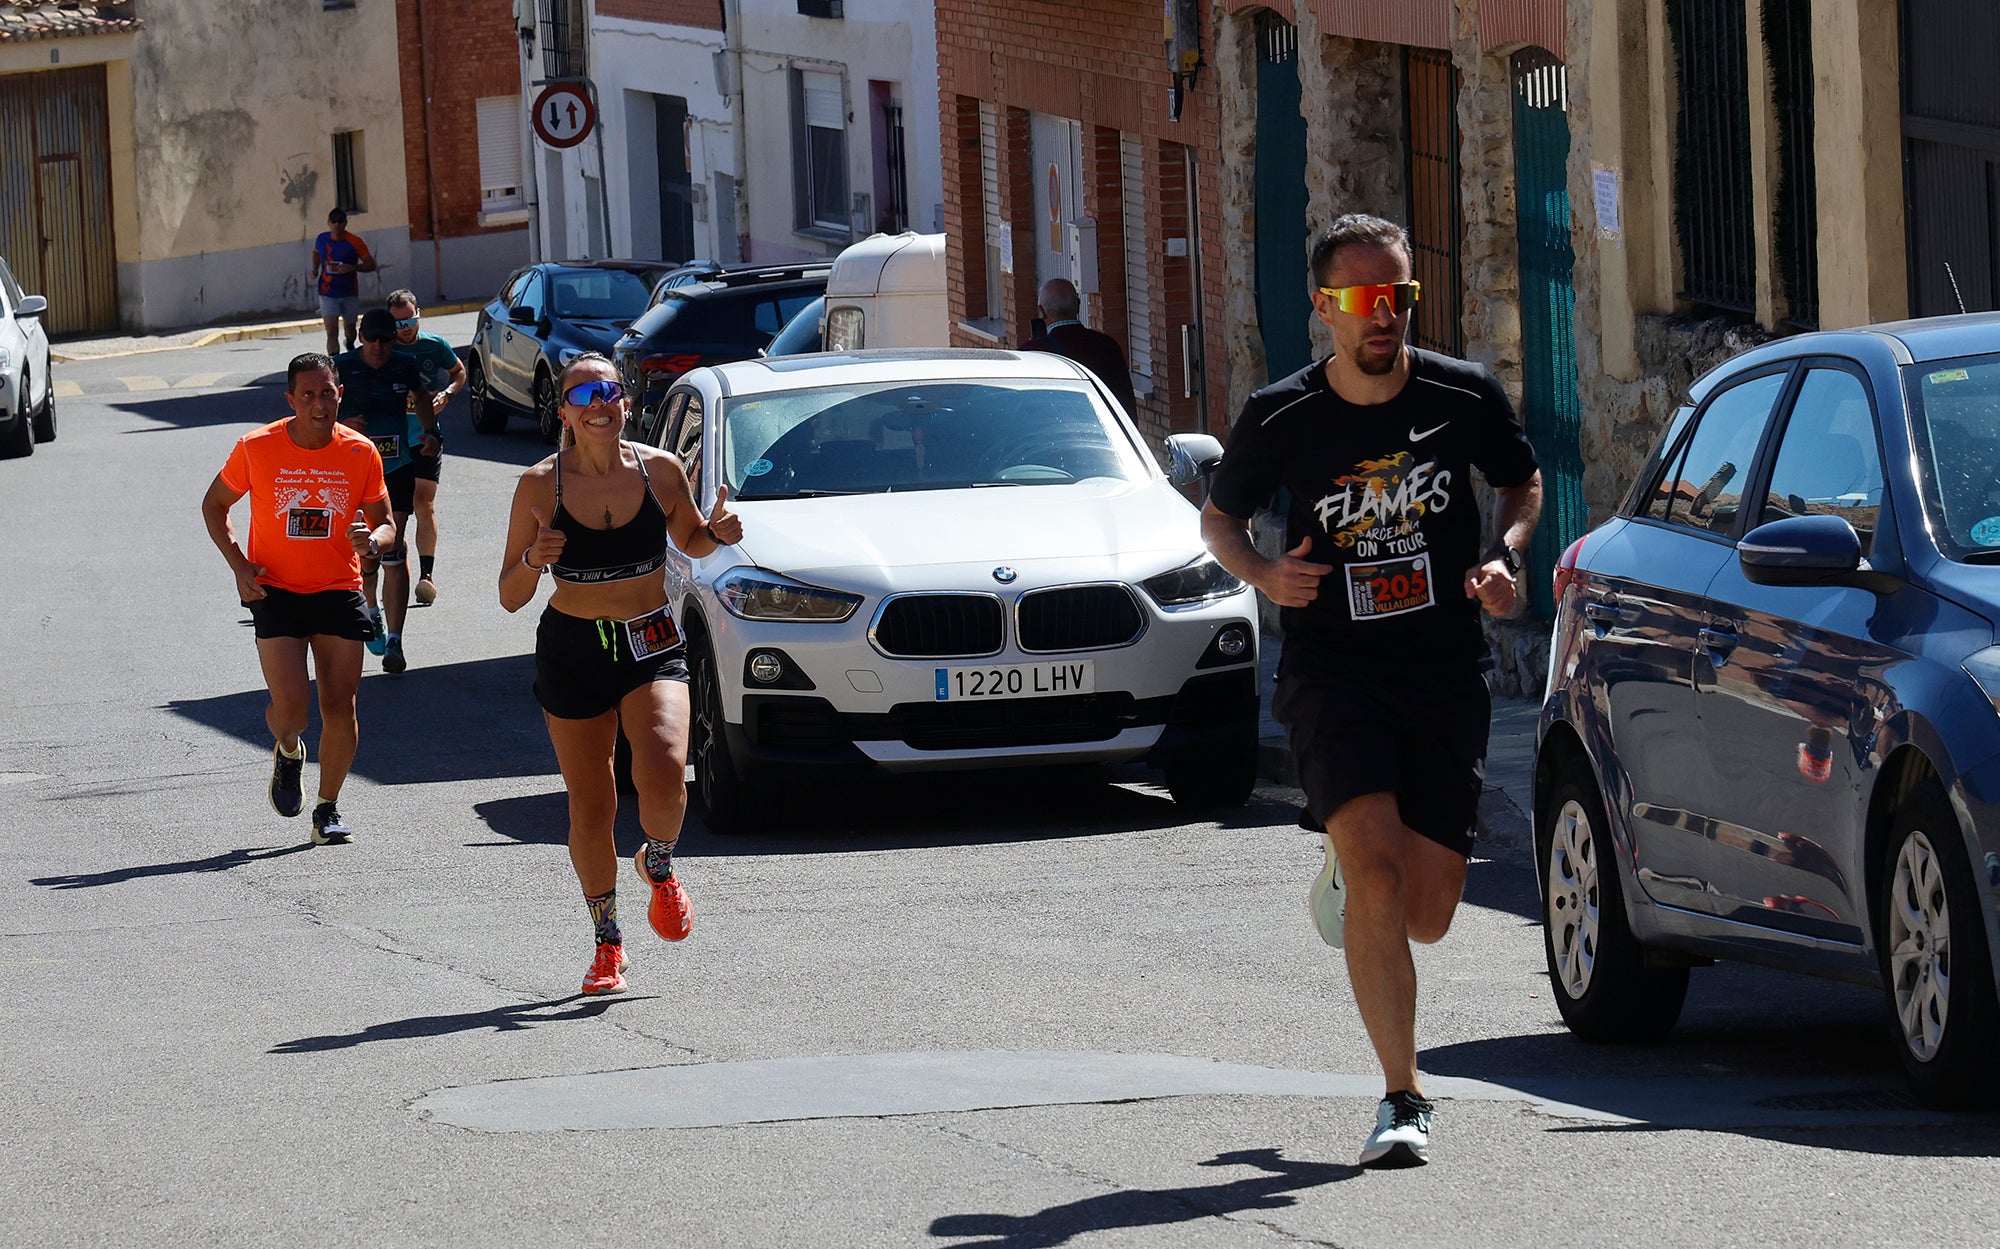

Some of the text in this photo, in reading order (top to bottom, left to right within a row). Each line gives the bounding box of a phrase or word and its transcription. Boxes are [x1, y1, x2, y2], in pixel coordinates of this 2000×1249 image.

[1313, 461, 1451, 535] FLAMES
[300, 515, 329, 530] 174
[1357, 532, 1427, 557] ON TOUR
[635, 561, 654, 575] NIKE
[1372, 570, 1427, 602] 205
[644, 617, 675, 643] 411
[939, 688, 945, 696] E
[955, 664, 1085, 697] 1220 LHV
